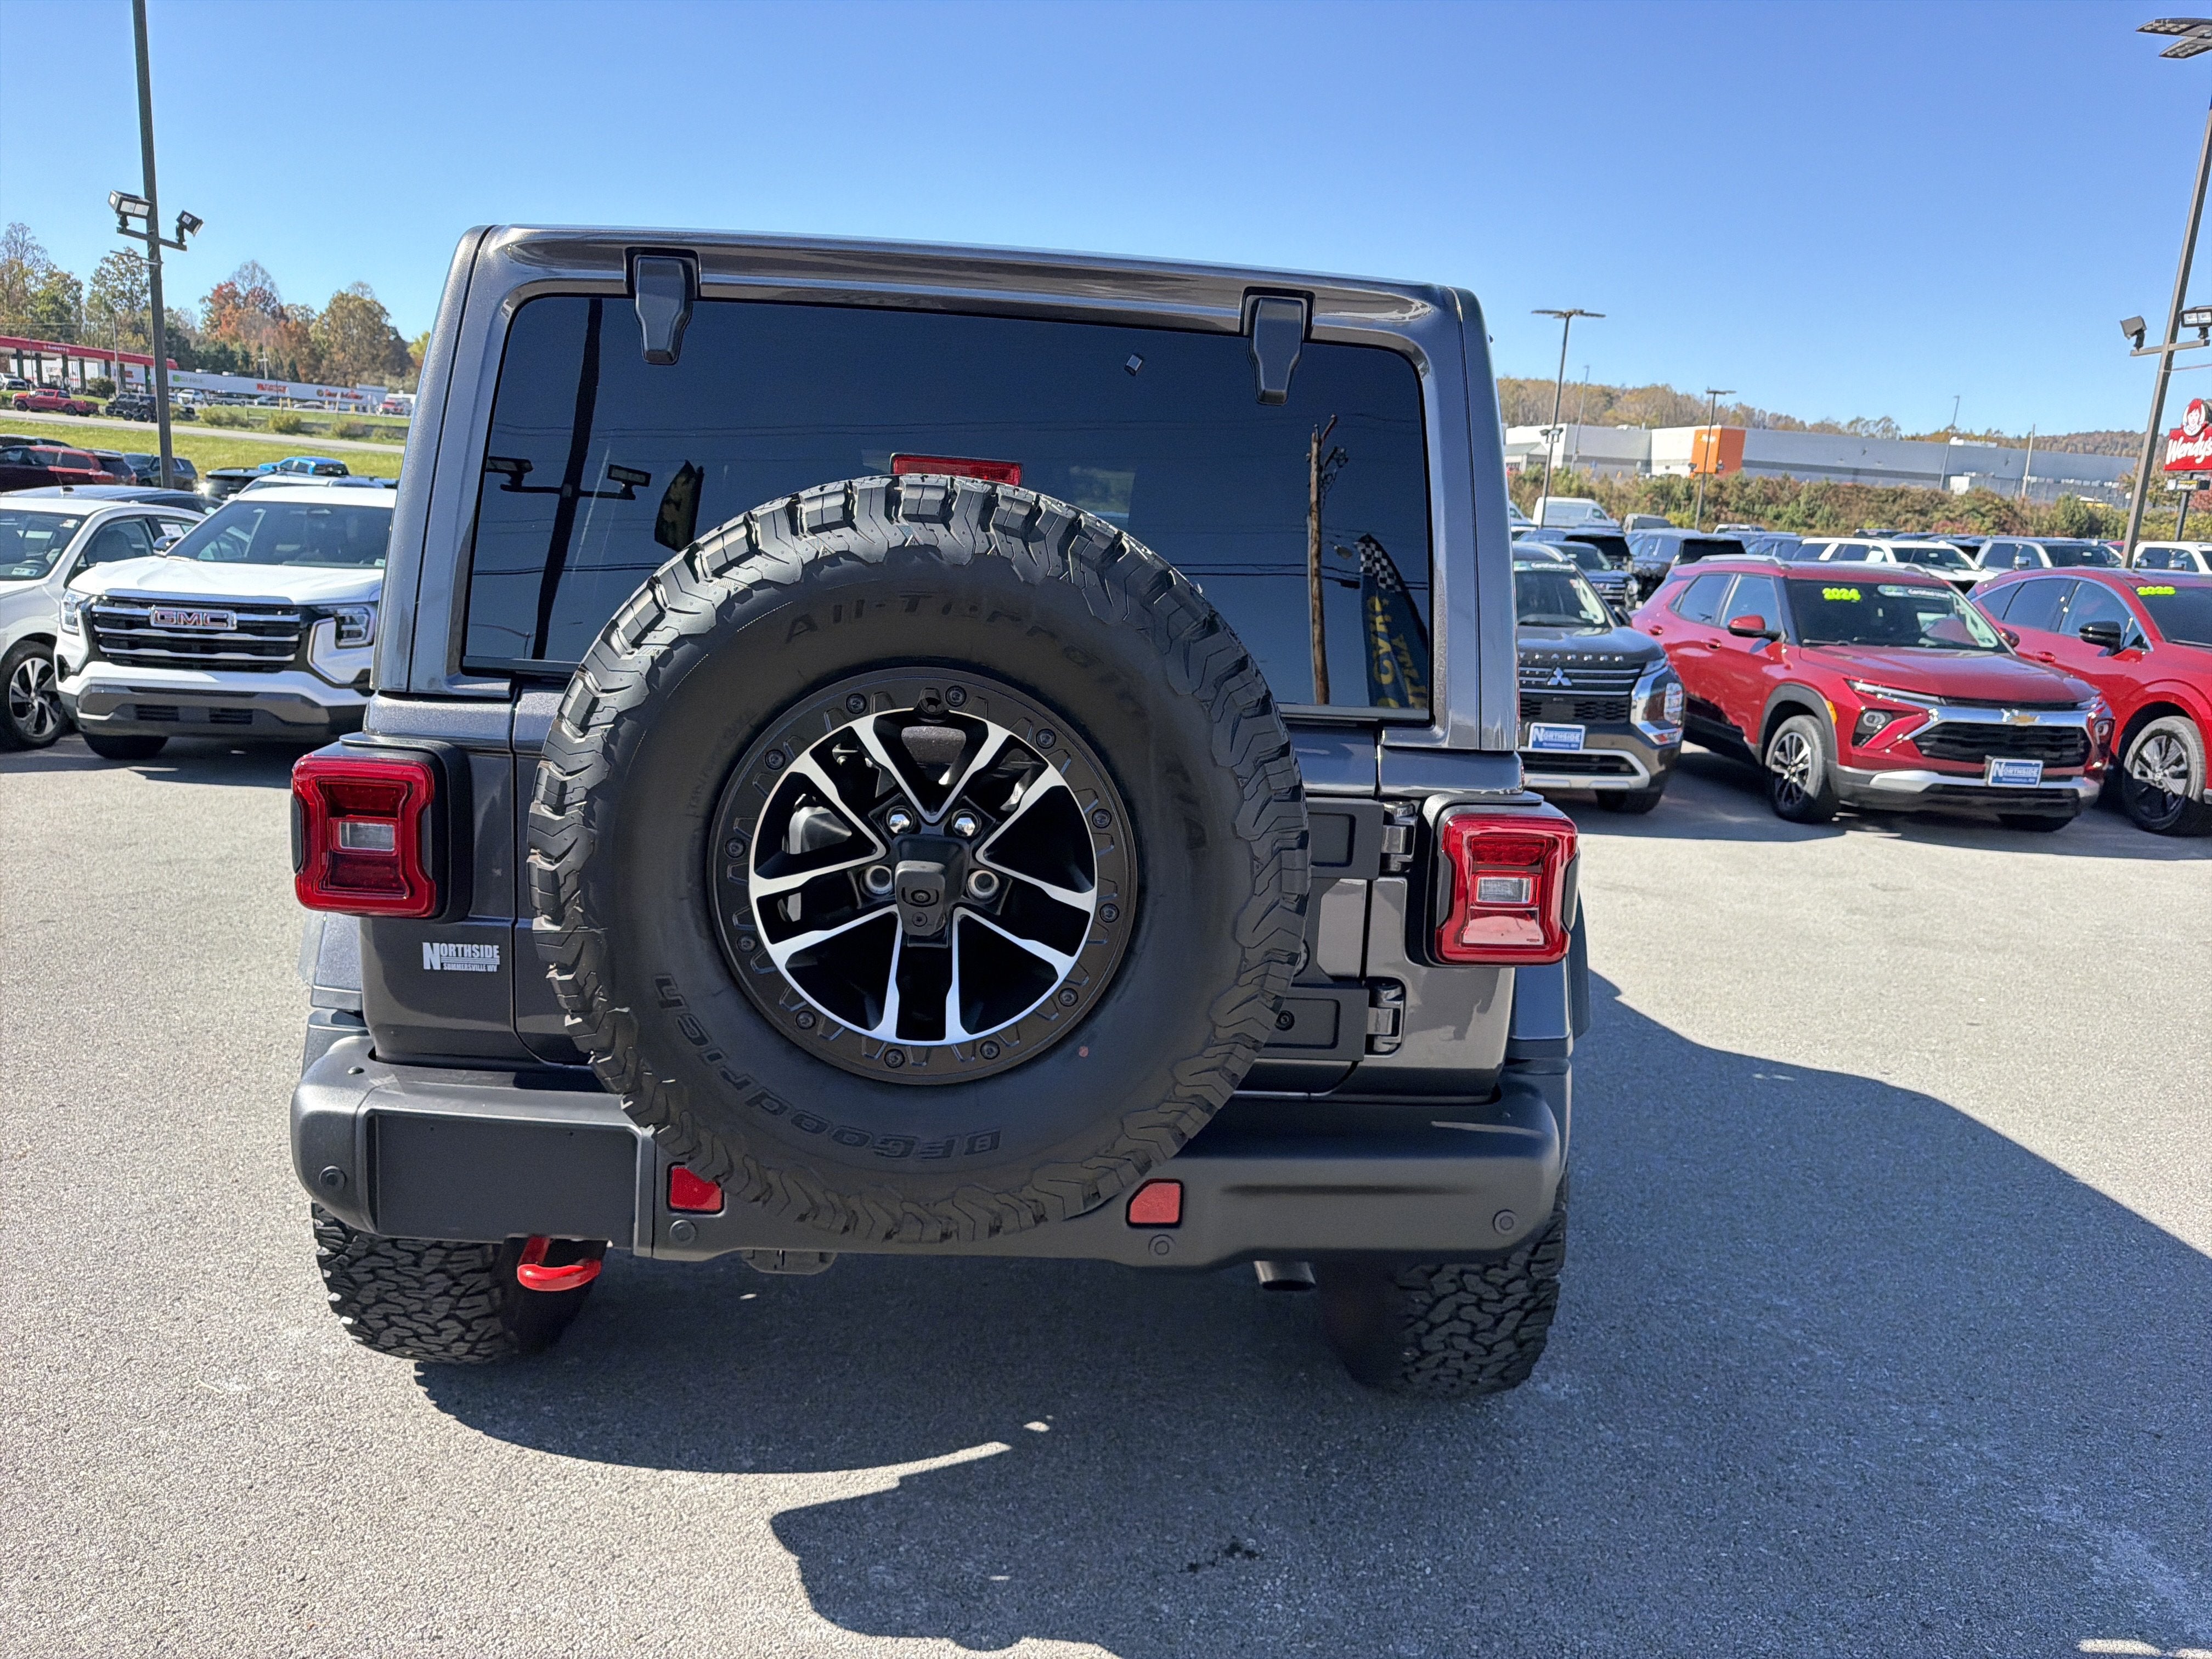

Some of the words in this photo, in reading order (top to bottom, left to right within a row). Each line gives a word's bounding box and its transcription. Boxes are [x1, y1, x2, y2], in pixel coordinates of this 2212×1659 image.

[2165, 431, 2212, 465] Wendy's
[1822, 588, 1861, 601] 2024
[154, 609, 228, 628] GMC
[1533, 727, 1581, 742] NORTHSIDE
[1993, 763, 2038, 777] NORTHSIDE
[422, 942, 500, 970] NORTHSIDE
[443, 963, 486, 972] SUMMERSVILLE
